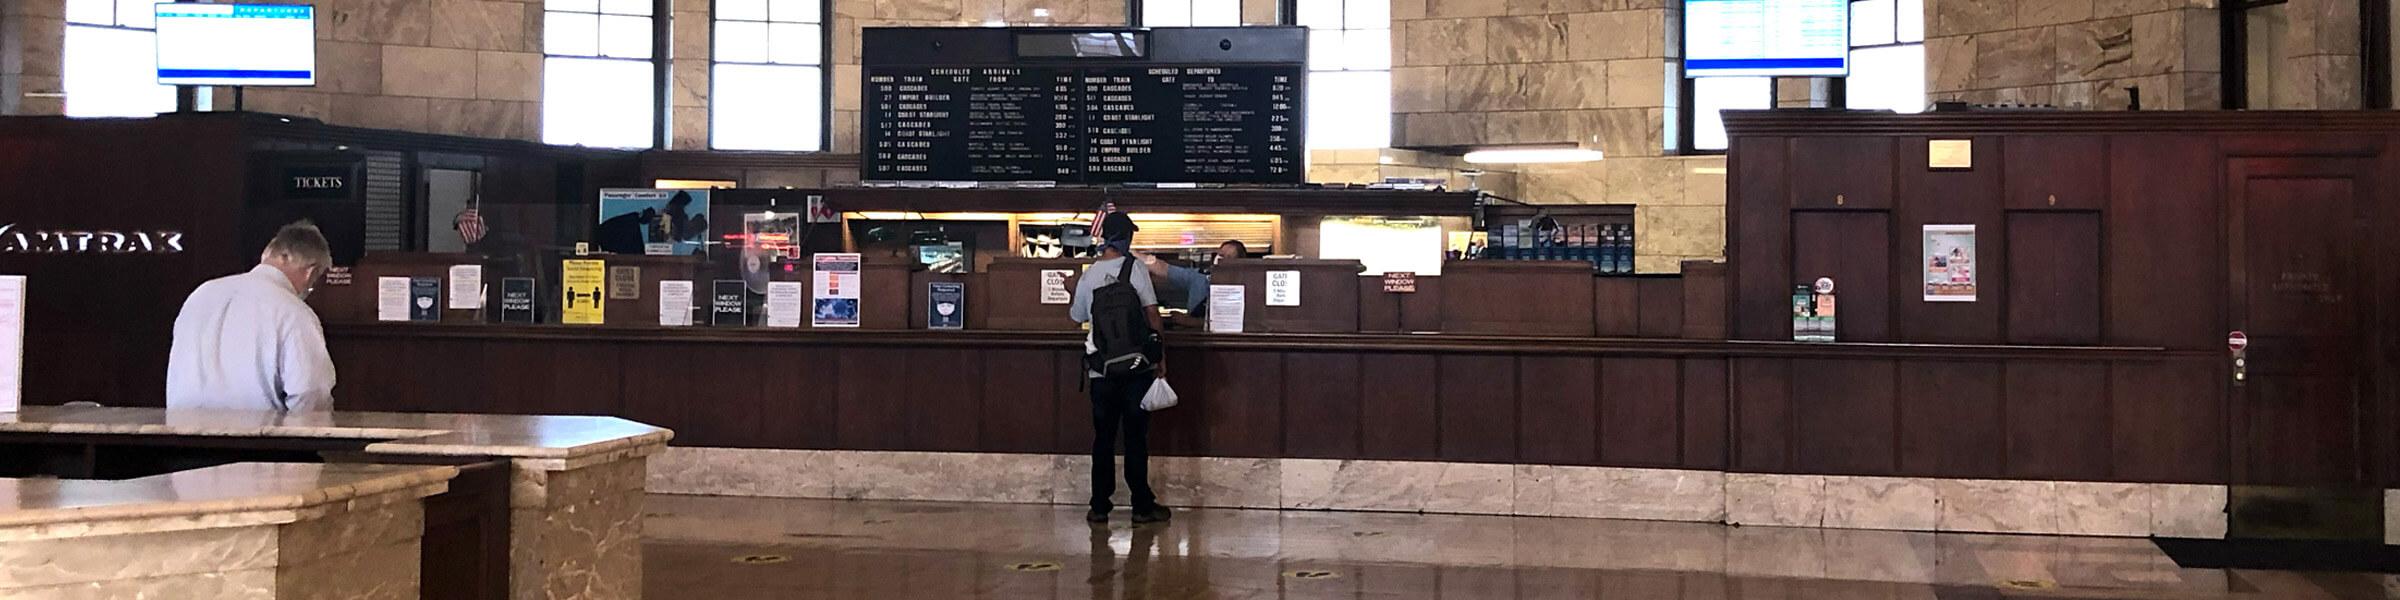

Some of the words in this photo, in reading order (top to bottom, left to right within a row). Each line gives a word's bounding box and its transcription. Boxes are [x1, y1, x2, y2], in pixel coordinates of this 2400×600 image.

[293, 176, 342, 188] TICKETS
[1837, 194, 1844, 205] 8
[2048, 194, 2055, 205] 9
[5, 231, 183, 251] AMTRAK
